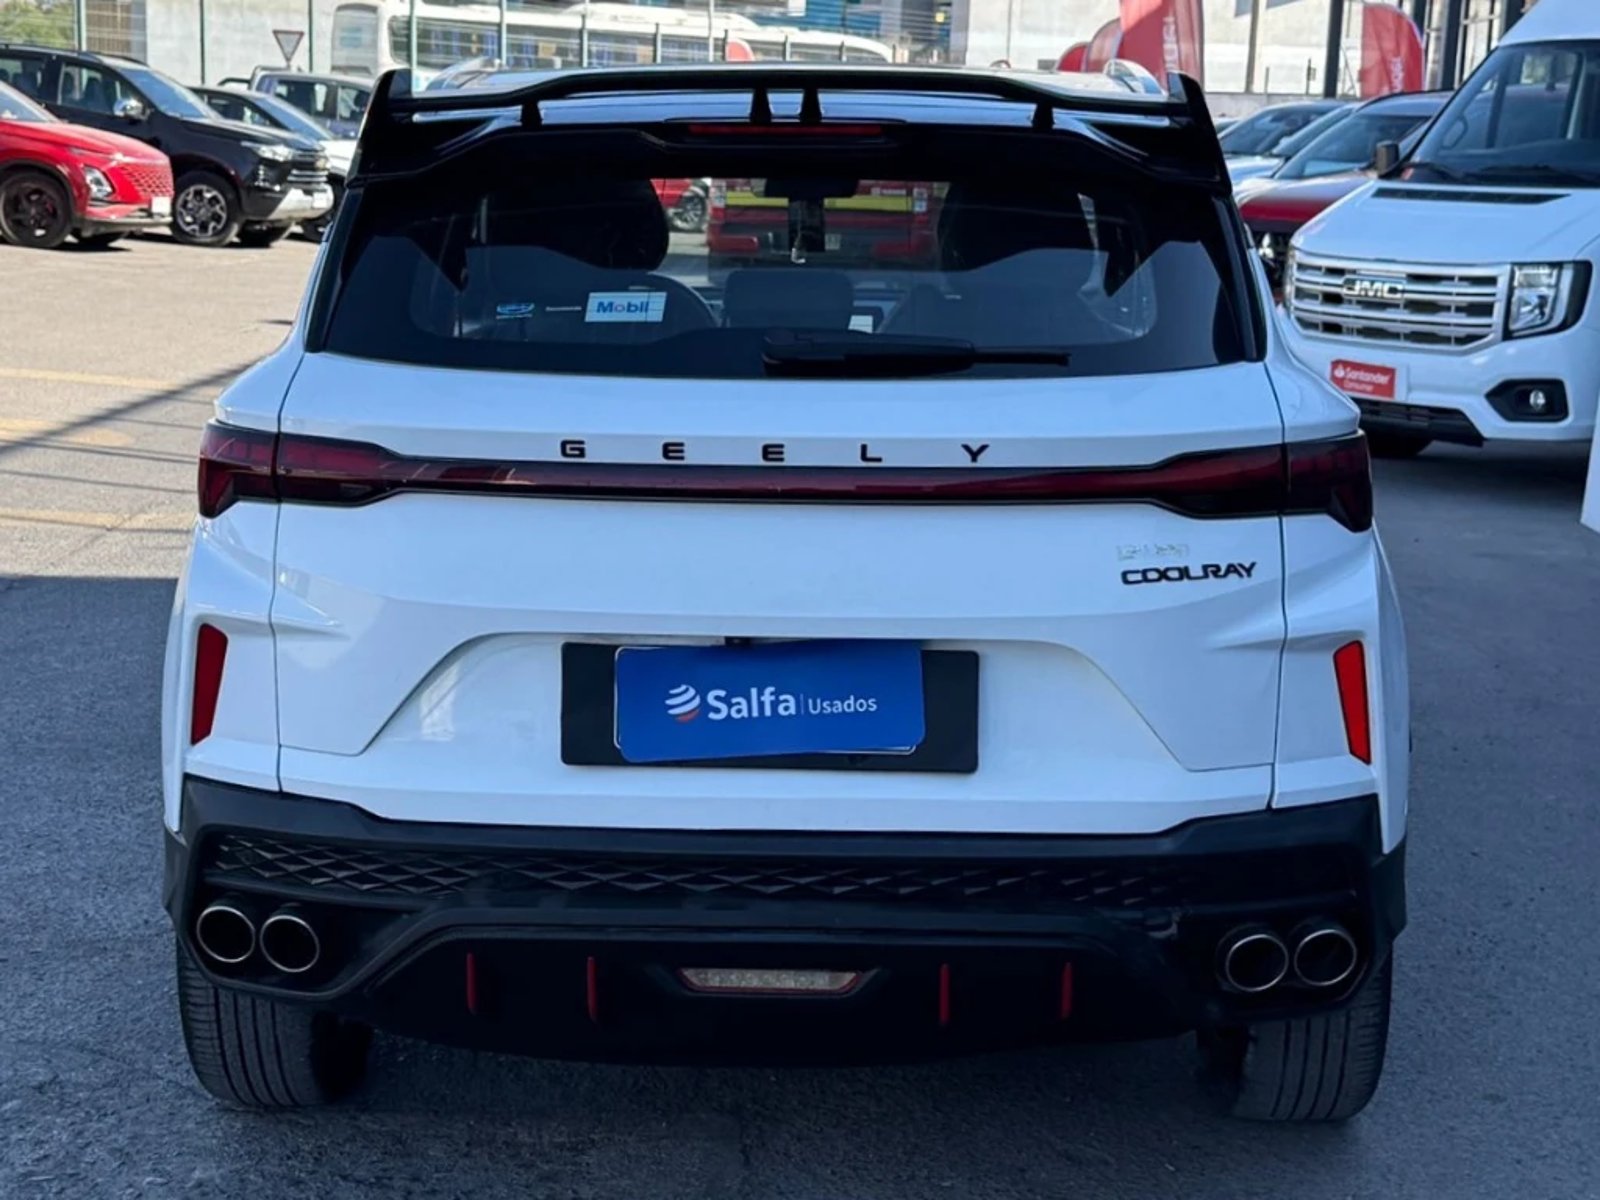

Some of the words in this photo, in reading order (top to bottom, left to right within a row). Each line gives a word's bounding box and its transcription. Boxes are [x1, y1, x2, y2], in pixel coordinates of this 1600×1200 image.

[1342, 278, 1404, 299] JMC
[596, 301, 649, 314] Mobil
[1345, 366, 1392, 385] Santander
[560, 440, 990, 463] GEELY
[1120, 561, 1257, 586] COOLRAY
[706, 686, 797, 720] Salfa
[808, 695, 878, 715] Usados
